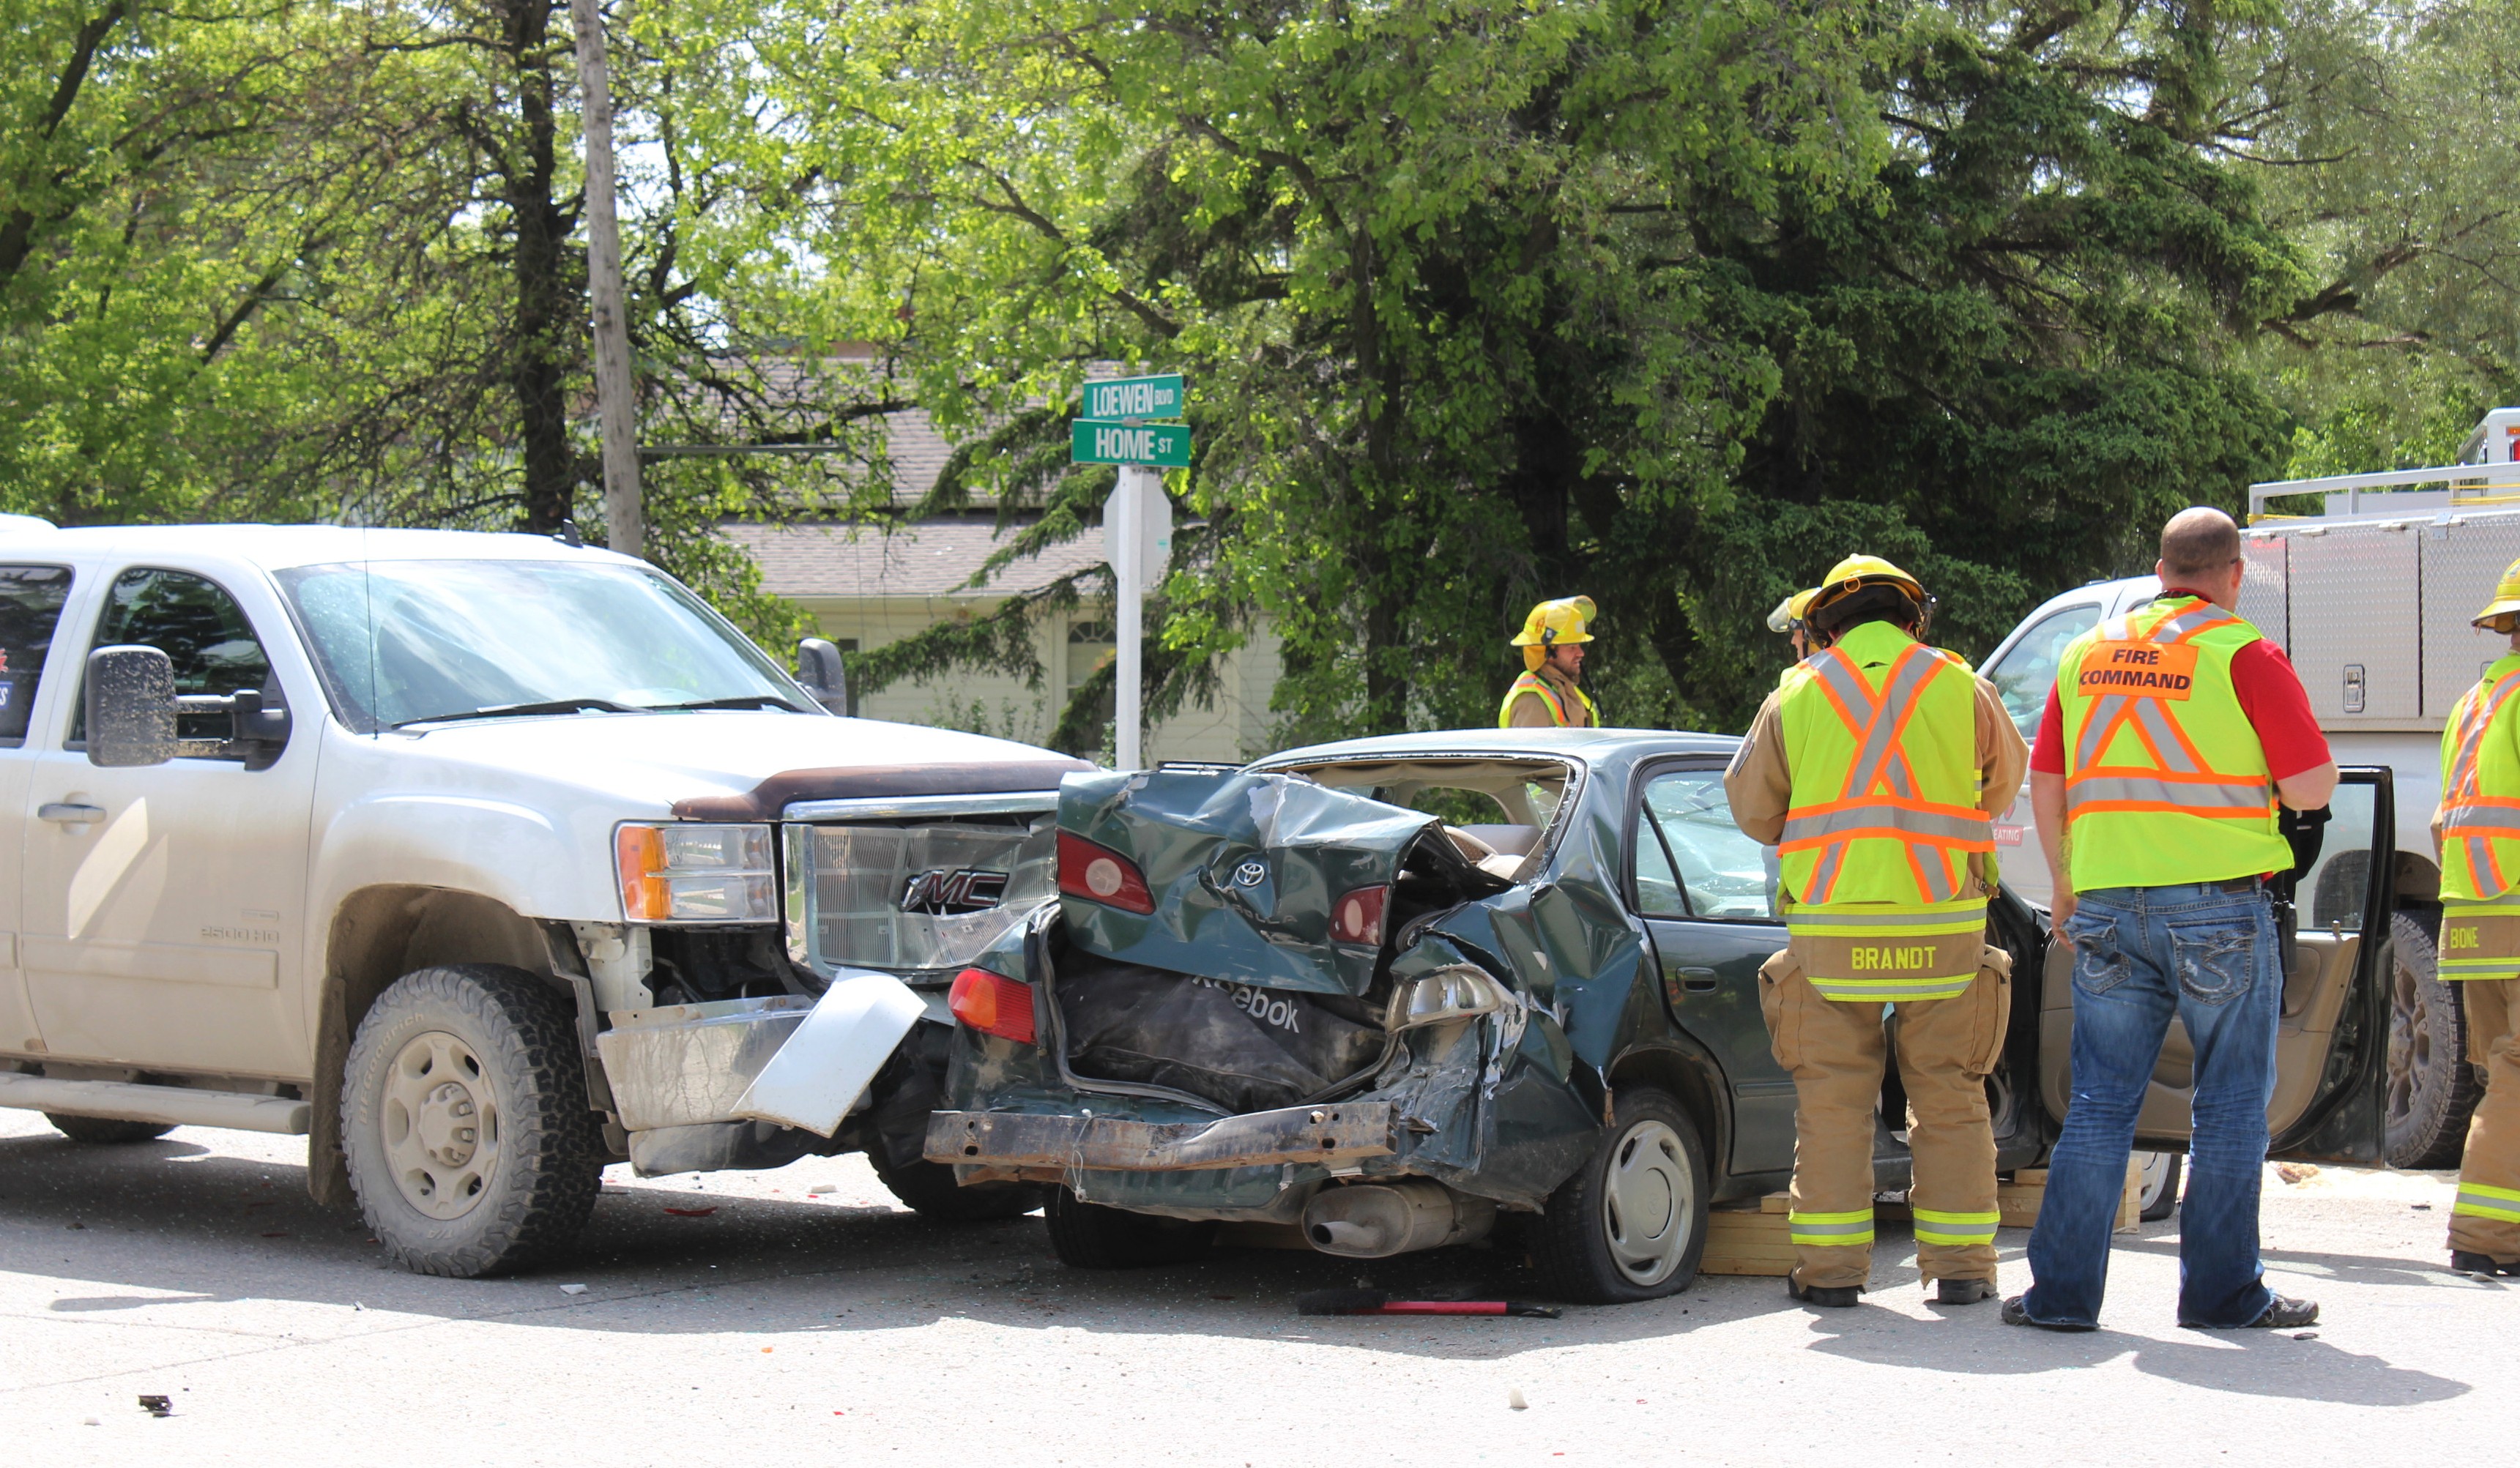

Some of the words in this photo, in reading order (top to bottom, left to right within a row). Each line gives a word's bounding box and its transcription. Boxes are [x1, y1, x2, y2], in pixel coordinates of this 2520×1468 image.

[1093, 383, 1153, 417] LOEWEN
[1154, 389, 1174, 406] BLVD
[1096, 428, 1156, 461] HOME
[1158, 438, 1174, 454] ST
[2112, 649, 2159, 665] FIRE
[2080, 670, 2190, 690] COMMAND
[1993, 829, 2019, 841] EATING
[2450, 927, 2479, 949] BONE
[1851, 946, 1936, 970] BRANDT
